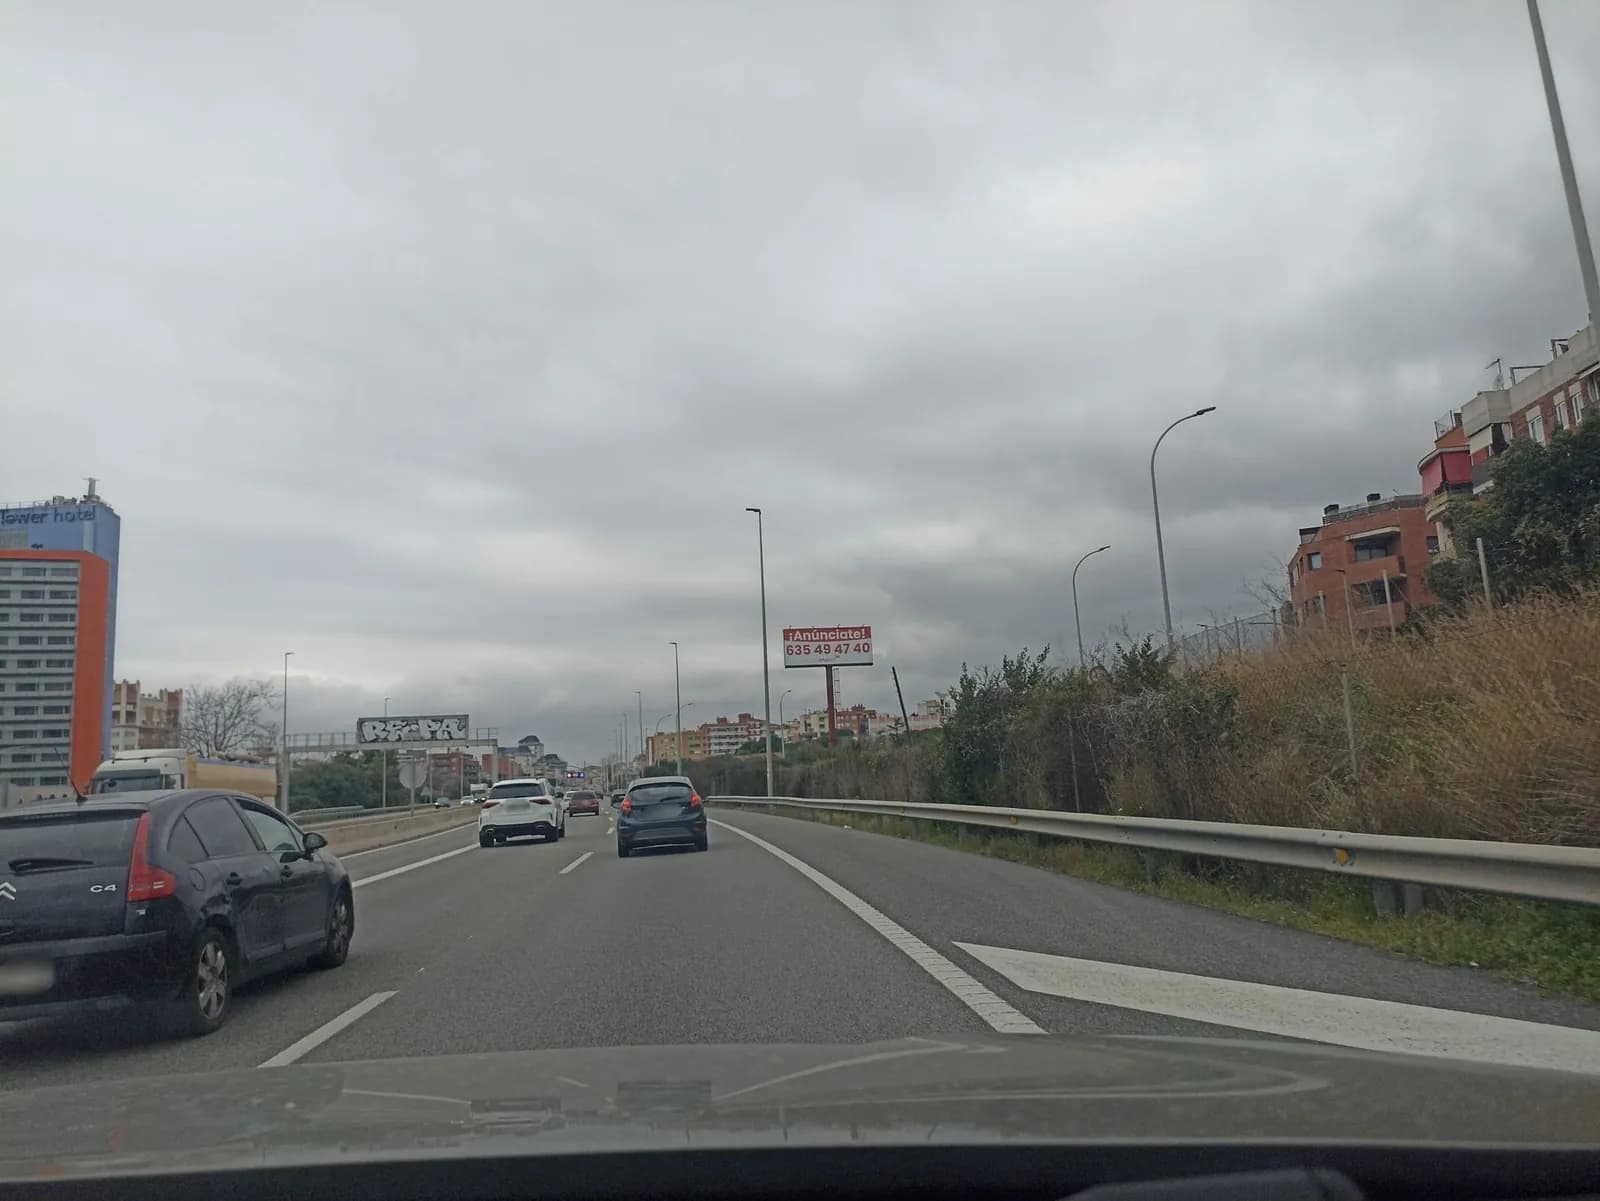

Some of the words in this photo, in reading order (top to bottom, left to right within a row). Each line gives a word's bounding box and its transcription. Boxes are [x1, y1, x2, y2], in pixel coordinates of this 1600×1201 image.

[54, 505, 96, 523] hotel
[788, 628, 866, 642] ¡Anúnciate!
[786, 644, 811, 656] 635
[814, 644, 831, 655] 49
[834, 643, 850, 655] 47
[853, 642, 870, 654] 40
[90, 884, 118, 893] C4
